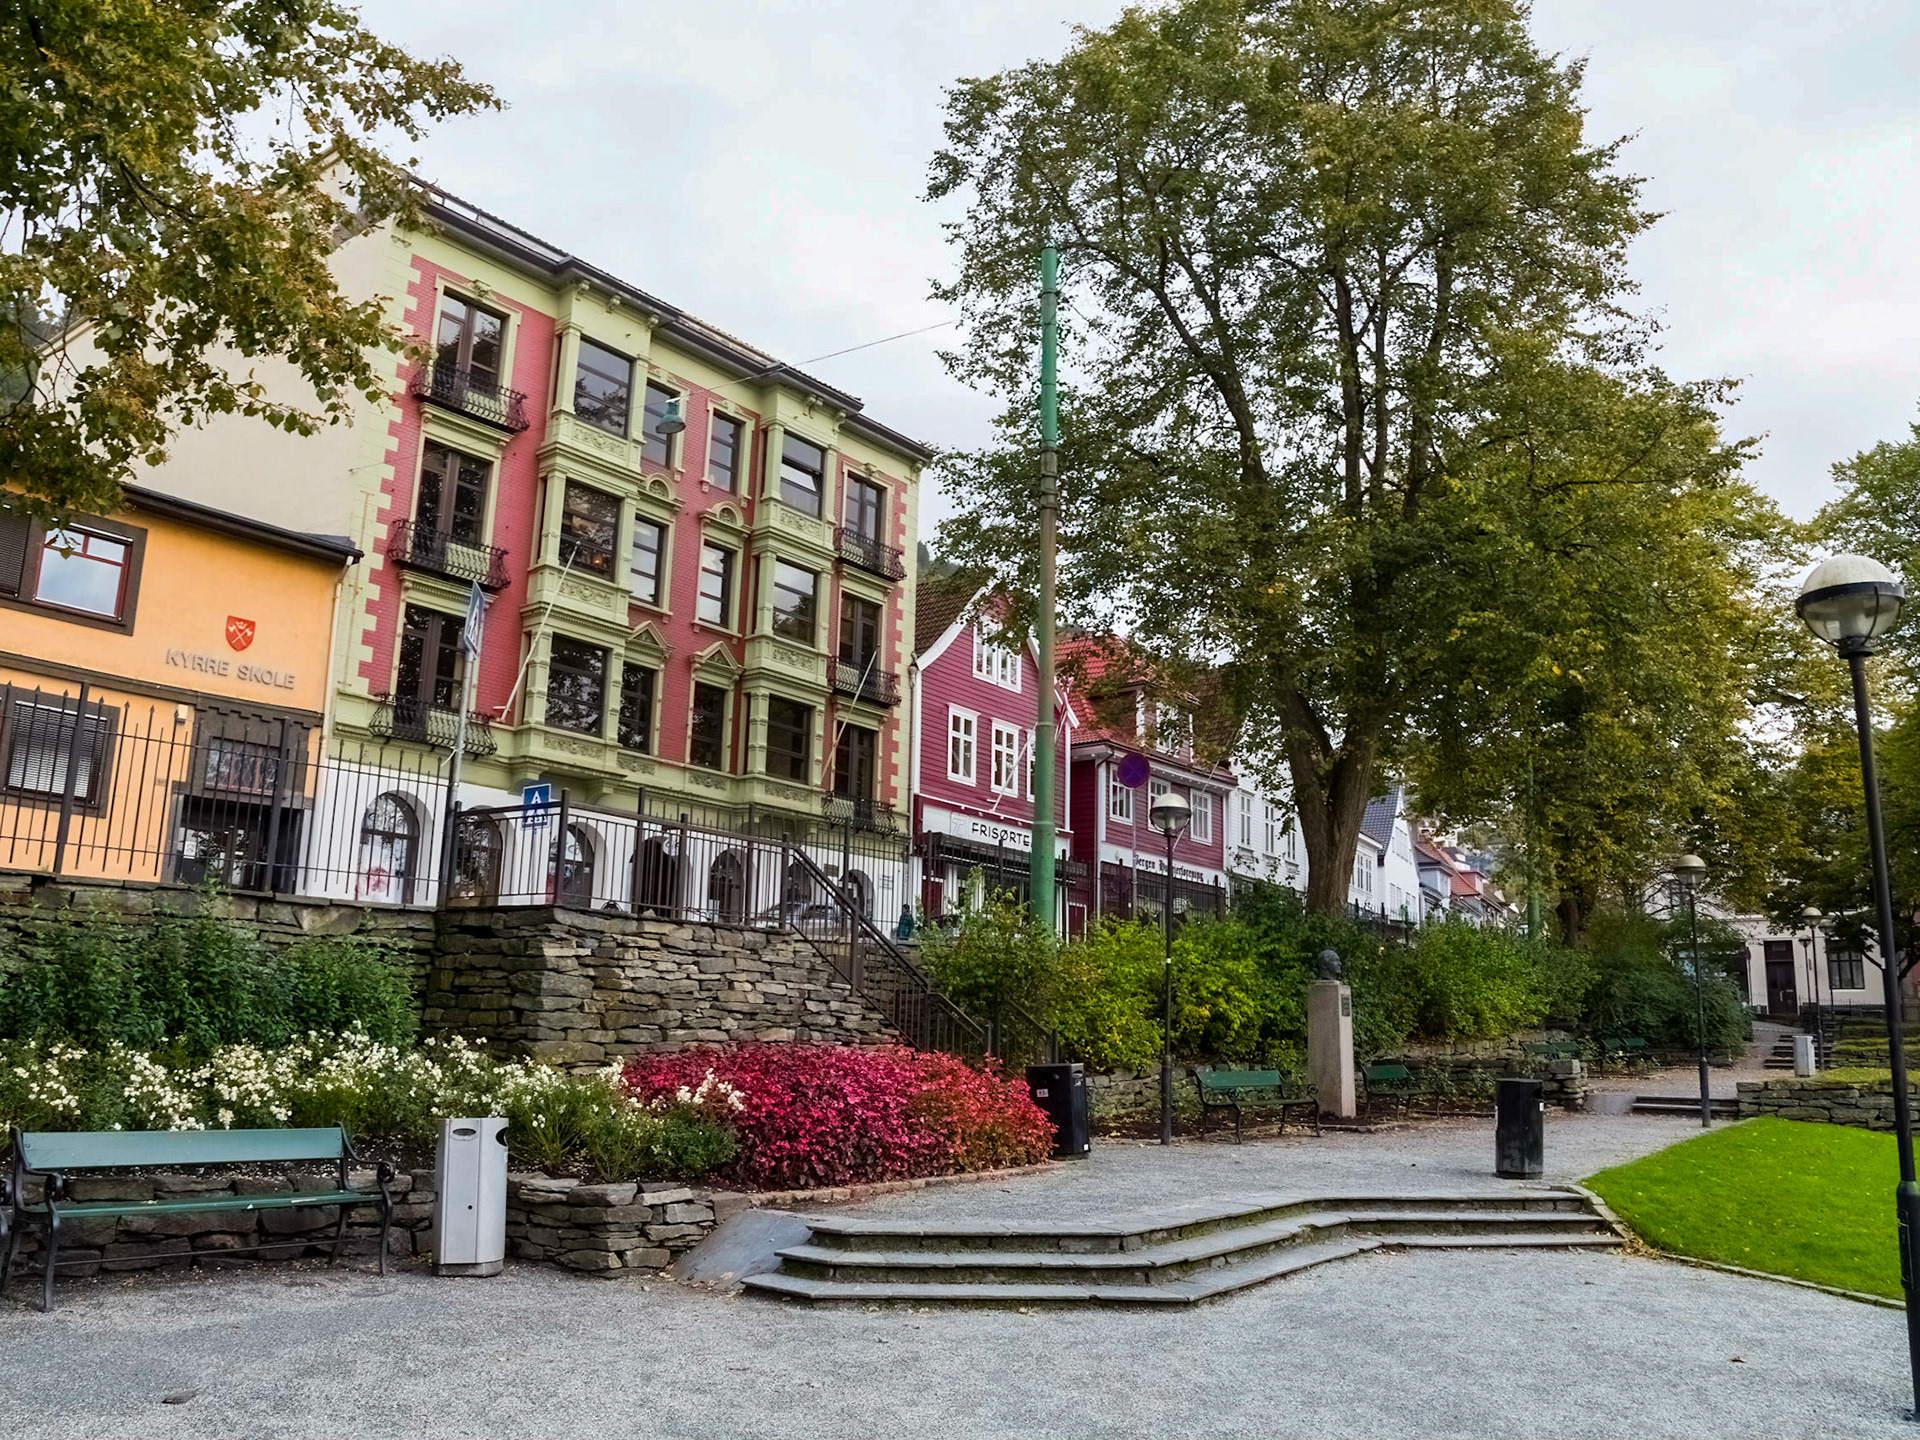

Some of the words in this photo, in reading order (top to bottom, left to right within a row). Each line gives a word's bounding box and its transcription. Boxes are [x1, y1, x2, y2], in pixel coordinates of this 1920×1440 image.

[166, 648, 230, 677] KYRRE
[237, 664, 296, 690] SKOLE
[971, 822, 1031, 847] FRISØRTE
